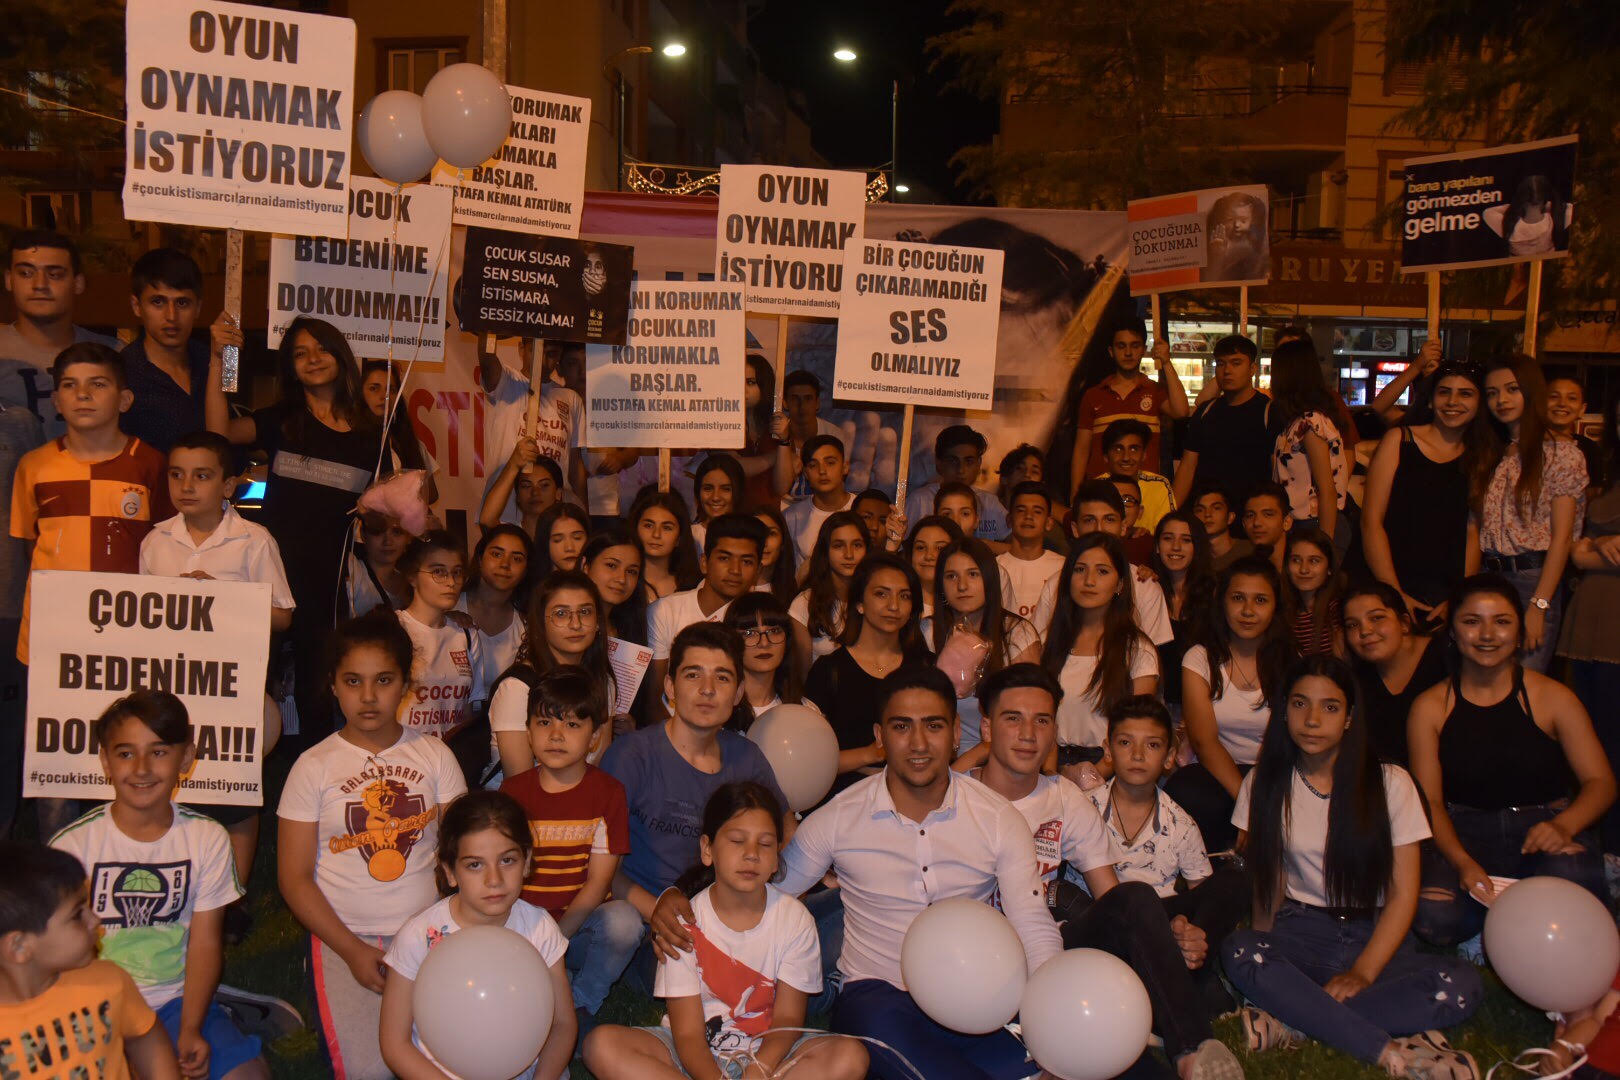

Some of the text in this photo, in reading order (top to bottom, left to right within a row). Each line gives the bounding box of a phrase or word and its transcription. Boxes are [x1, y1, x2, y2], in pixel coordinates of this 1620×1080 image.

[190, 10, 299, 64] OYUN
[140, 67, 342, 130] OYNAMAK
[510, 96, 582, 123] ORUMAK
[510, 121, 556, 144] KLARI
[133, 121, 345, 191] İSTİYORUZ
[758, 173, 829, 206] OYUN
[1408, 182, 1441, 193] bana
[350, 189, 412, 223] CUK
[487, 190, 522, 207] KEMAL
[524, 197, 572, 214] ATATÜRK
[1406, 190, 1503, 215] görmezden
[726, 213, 857, 251] OYNAMAK
[1132, 222, 1202, 244] ÇOCUĞUMA
[1405, 211, 1480, 240] gelme
[294, 235, 428, 274] BEDENİME
[485, 246, 571, 268] ÇOCUK SUSAR
[863, 243, 985, 275] BİR ÇOCUĞUN
[1134, 237, 1199, 256] DOKUNMA!
[483, 266, 559, 288] SEN SUSMA,
[720, 251, 843, 293] İSTİYORU
[482, 284, 550, 306] İSTİSMARA
[855, 272, 987, 303] ÇIKARAMADIĞI
[277, 282, 440, 325] DOKUNMA!!!
[654, 291, 742, 311] KORUMAK
[480, 307, 575, 328] SESSİZ KALMA!
[628, 318, 716, 338] OCUKLARI
[889, 308, 948, 345] SES
[612, 345, 720, 365] KORUMAKLA
[871, 352, 961, 378] OLMALIYIZ
[630, 373, 702, 396] BAŞLAR.
[591, 397, 740, 413] MUSTAFA KEMAL ATATÜRK
[89, 589, 215, 633] ÇOCUK
[59, 653, 238, 698] BEDENİME
[415, 685, 471, 704] ÇOCUK
[341, 765, 424, 794] GALATASARAY
[648, 817, 702, 839] FRANCIS
